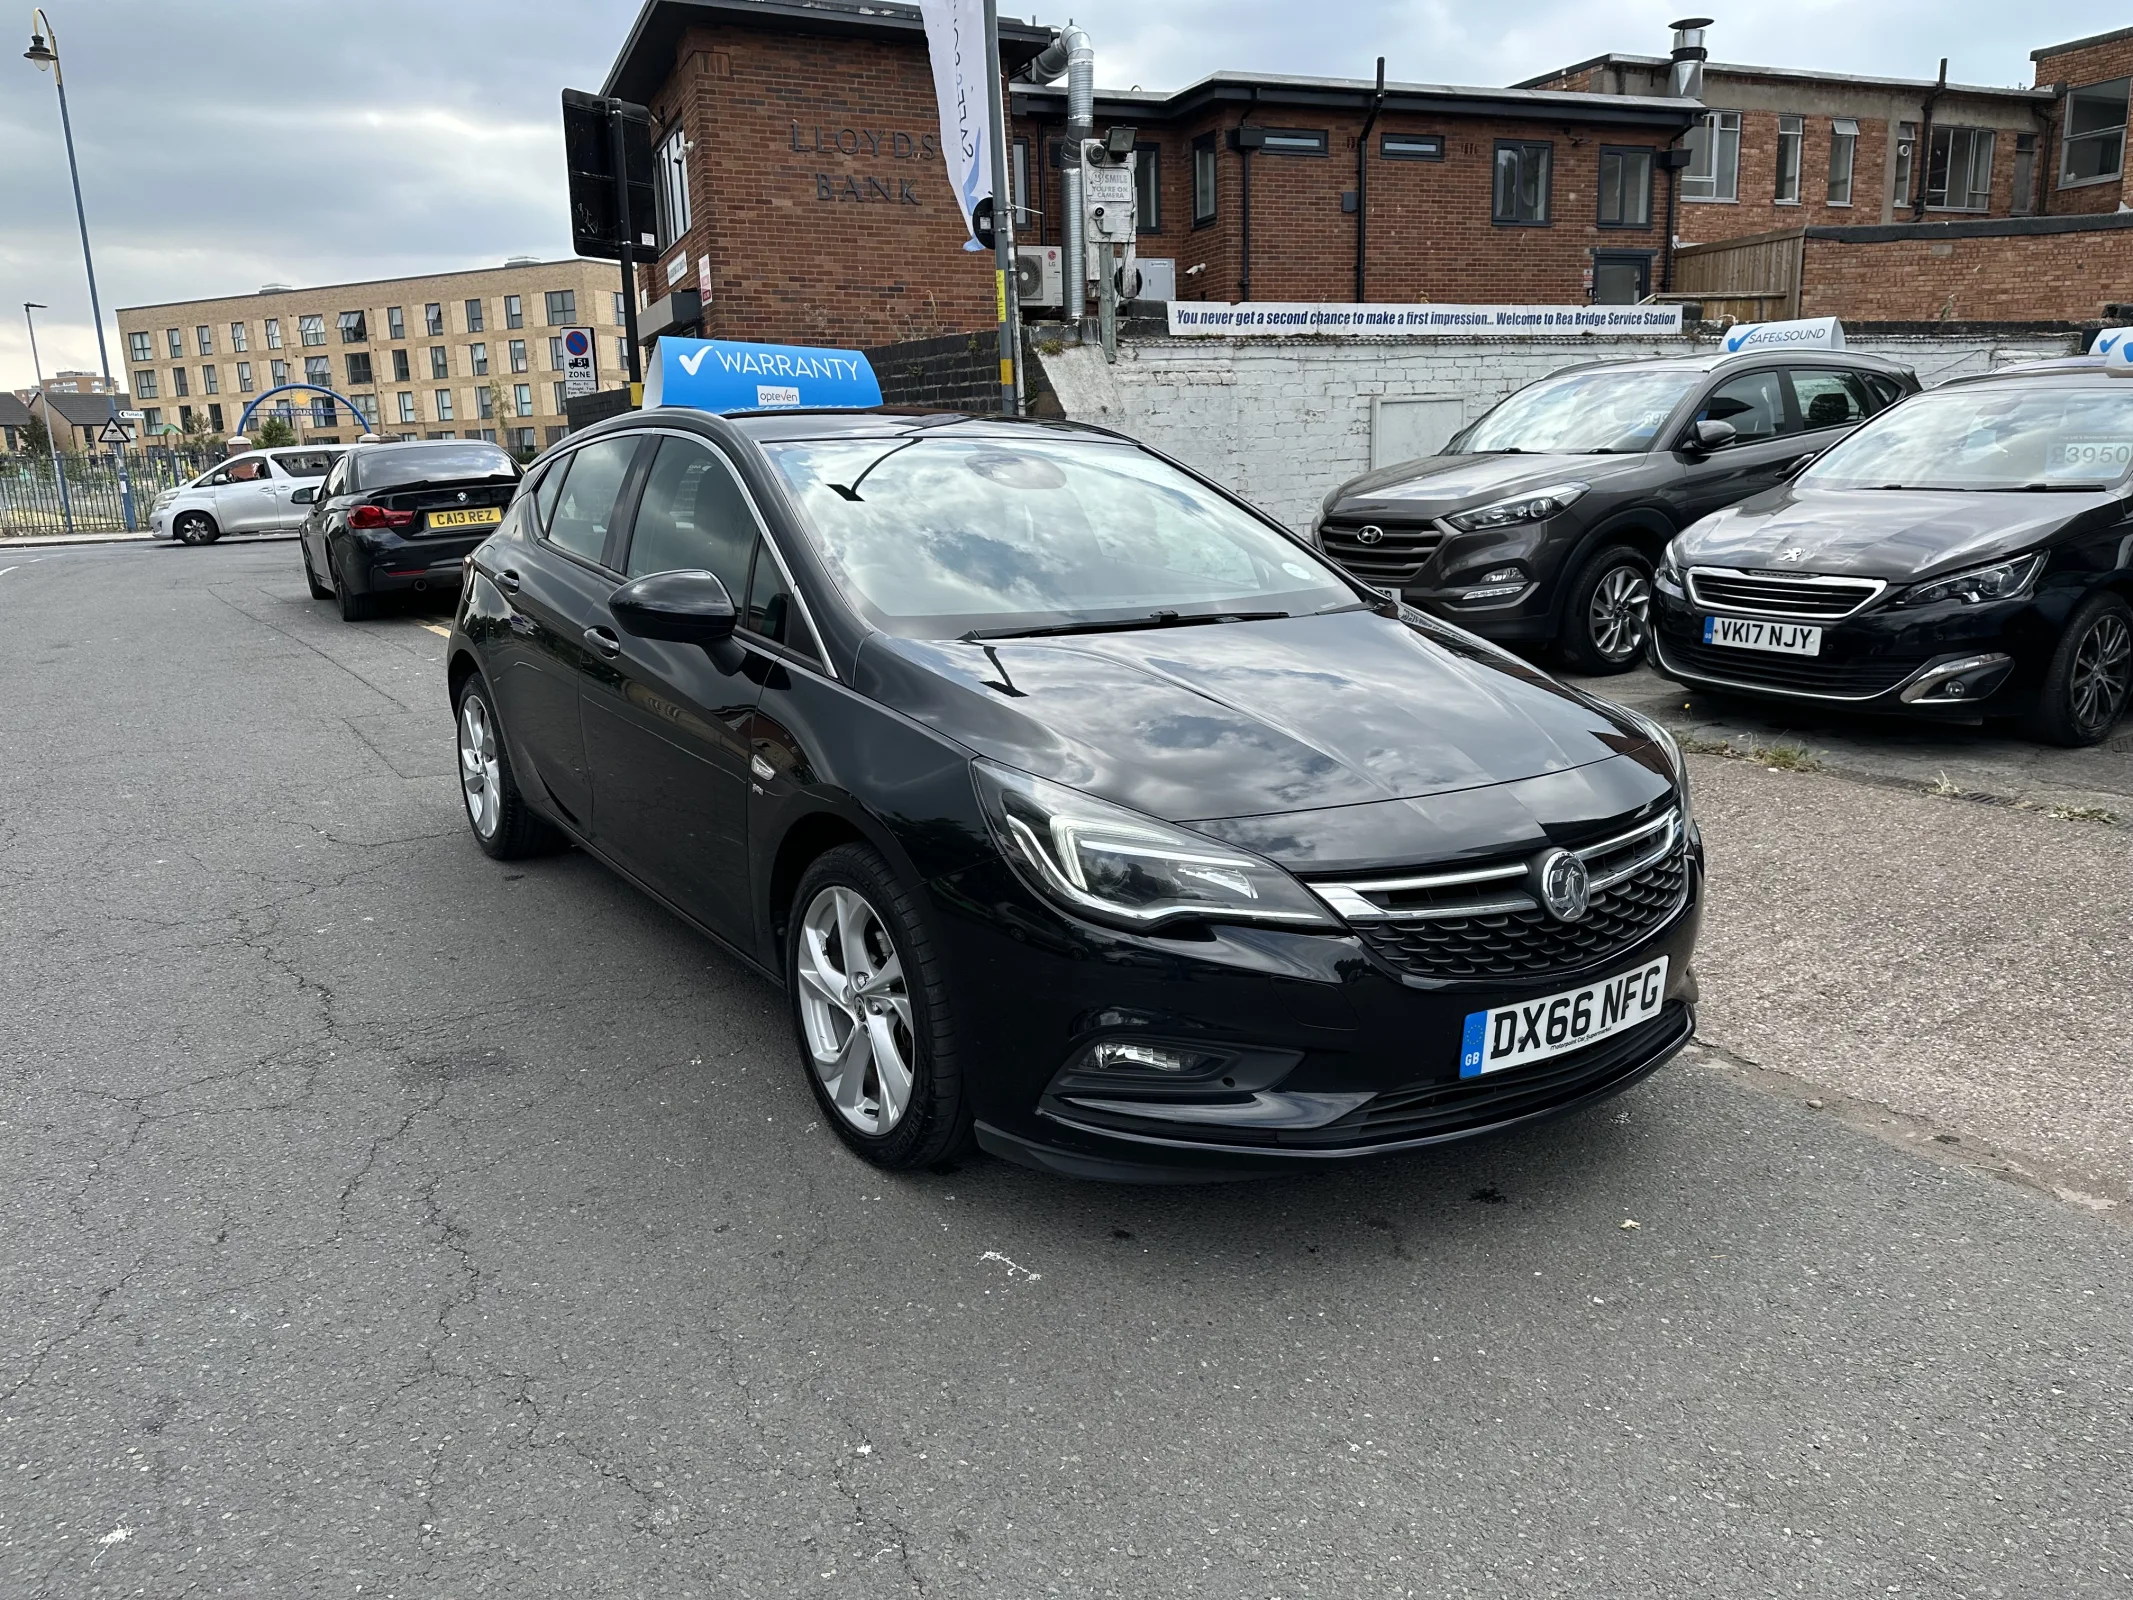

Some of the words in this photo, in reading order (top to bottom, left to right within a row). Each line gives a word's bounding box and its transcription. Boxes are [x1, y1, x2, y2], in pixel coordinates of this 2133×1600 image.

[791, 121, 936, 160] LLOYDS
[1104, 174, 1128, 184] SMILE
[815, 173, 923, 206] BANK
[1177, 310, 1198, 325] You
[1200, 311, 1234, 325] never
[1235, 311, 1255, 327] get
[1257, 313, 1264, 325] a
[1266, 310, 1307, 325] second
[1310, 310, 1351, 325] chance
[1353, 311, 1365, 325] to
[1366, 310, 1396, 325] make
[1397, 313, 1404, 325] a
[1406, 311, 1429, 325] first
[1430, 311, 1494, 326] impression...
[1496, 312, 1542, 325] Welcome
[1544, 312, 1553, 325] to
[1555, 312, 1573, 325] Rea
[1575, 312, 1606, 327] Bridge
[1608, 312, 1648, 325] Service
[1649, 312, 1676, 325] Station
[1749, 328, 1826, 344] SAFE&SOUND
[715, 350, 858, 381] WARRANTY
[760, 389, 798, 402] opteven
[437, 512, 466, 525] CA13
[468, 510, 494, 522] REZ
[1721, 620, 1764, 644] VK17
[1768, 625, 1813, 649] NJY
[1490, 990, 1594, 1060] DX66
[1600, 965, 1661, 1029] NFG
[1586, 1026, 1612, 1041] Supermarket
[1465, 1052, 1480, 1066] GB
